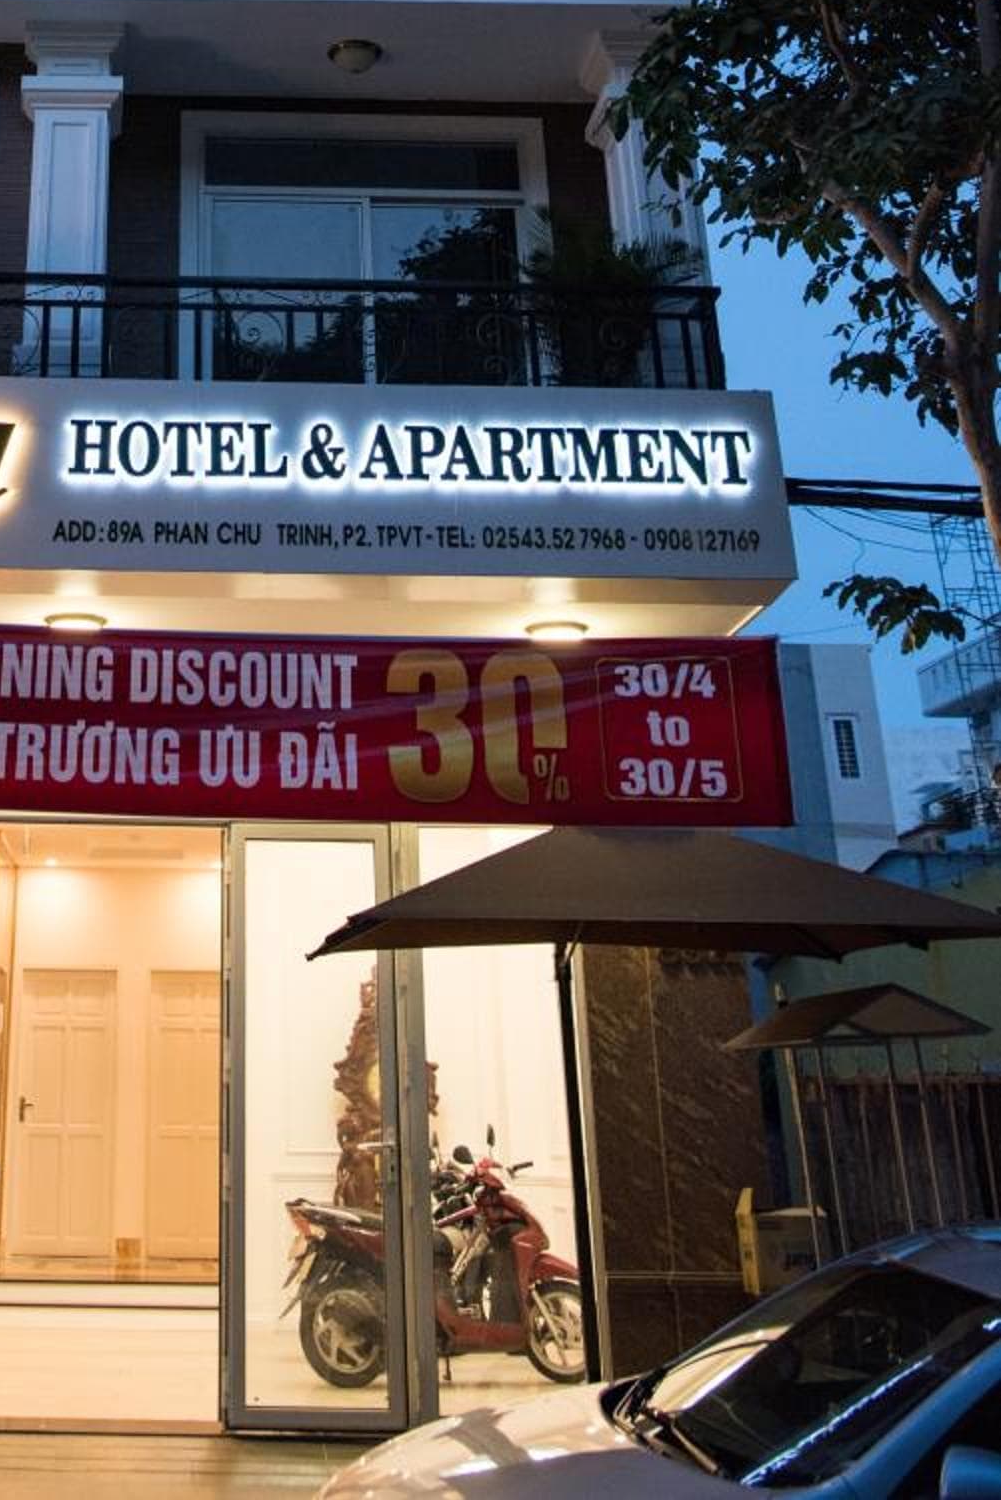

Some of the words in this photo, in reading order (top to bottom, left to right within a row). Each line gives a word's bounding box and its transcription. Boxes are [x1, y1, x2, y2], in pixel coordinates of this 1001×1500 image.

[68, 419, 288, 477] HOTEL
[302, 423, 346, 479] &
[360, 424, 751, 485] APARTMENT
[154, 521, 208, 545] PHAN
[216, 522, 262, 545] CHU
[129, 648, 359, 709] DISCOUNT
[614, 663, 715, 698] 30/4
[647, 710, 690, 747] to
[199, 723, 261, 788] ƯU
[278, 721, 358, 790] ĐÃI
[619, 757, 727, 798] 30/5
